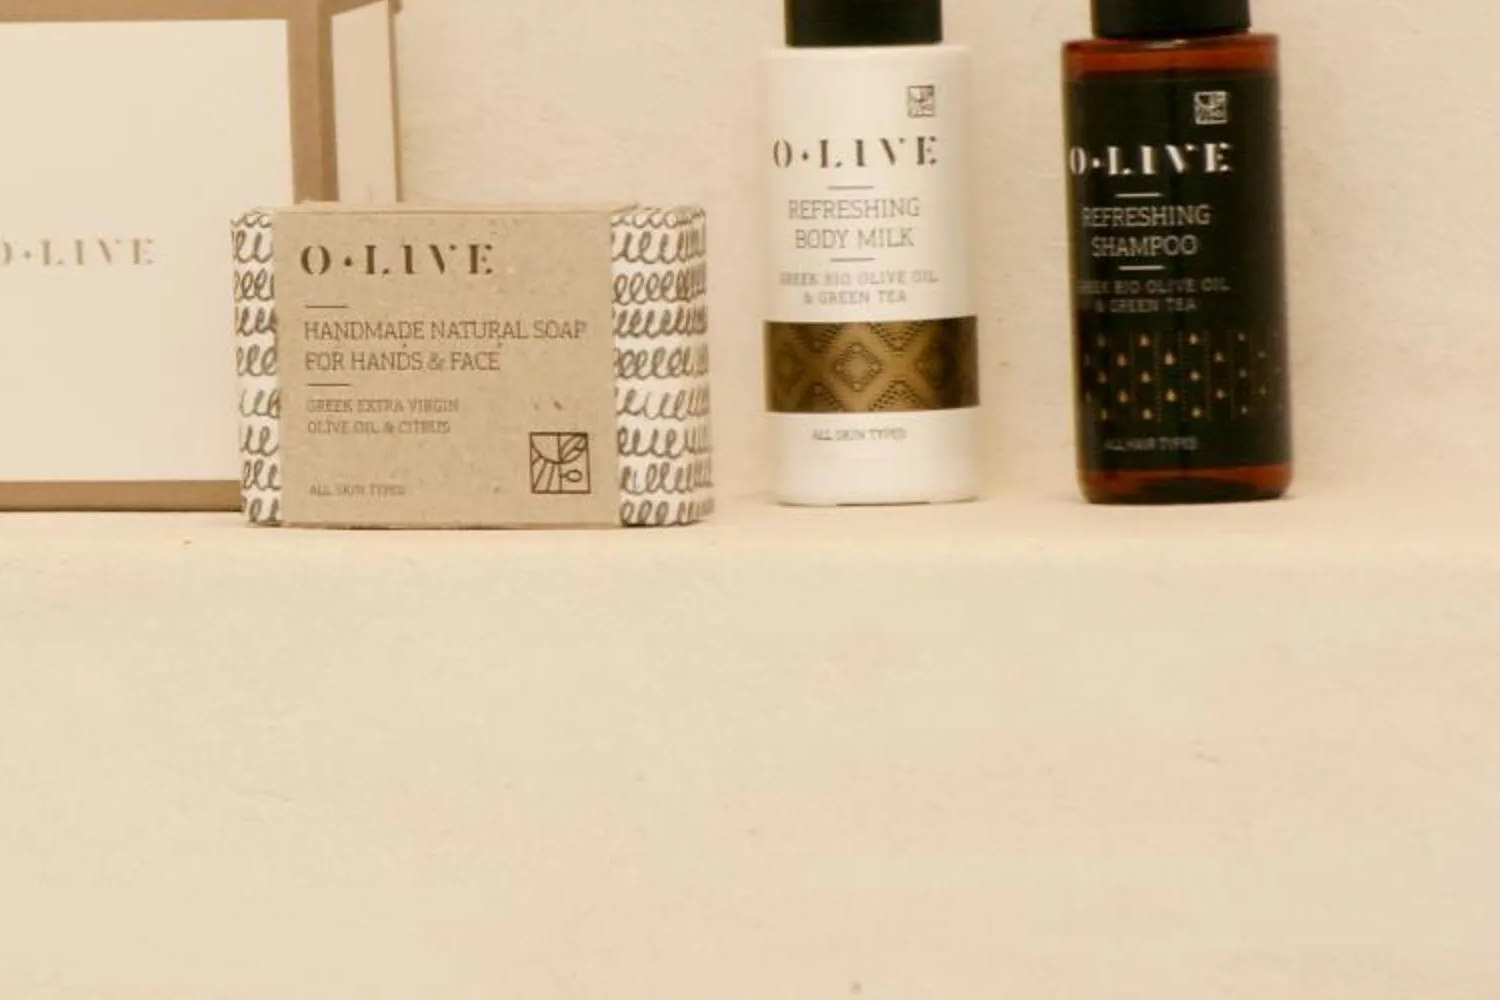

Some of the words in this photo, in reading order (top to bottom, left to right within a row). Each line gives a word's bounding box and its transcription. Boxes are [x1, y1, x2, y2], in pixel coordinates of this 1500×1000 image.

[787, 197, 922, 220] REFRESHING
[1080, 203, 1213, 227] REFRESHING
[794, 228, 850, 249] BODY
[857, 226, 916, 249] MILK
[1091, 233, 1200, 257] SHAMPOO
[857, 269, 907, 286] OLIVE
[911, 268, 940, 284] OIL
[1145, 278, 1198, 295] OLIVE
[1201, 276, 1232, 292] OIL
[817, 290, 870, 305] GREEN
[877, 289, 908, 303] TEA
[1165, 297, 1198, 312] TEA
[304, 320, 425, 341] HANDMADE
[430, 320, 528, 341] NATURAL
[533, 320, 587, 340] SOAP
[304, 351, 347, 371] FOR
[350, 351, 424, 371] HANDS
[428, 352, 446, 371] &
[451, 351, 501, 371] FACE
[306, 399, 353, 413] GREEK
[357, 399, 405, 413] EXTRA
[407, 398, 460, 413] VIRGIN
[307, 419, 349, 435] OLIVE
[353, 419, 380, 435] OIL
[398, 419, 451, 434] CITRUS
[309, 483, 332, 497] ALL
